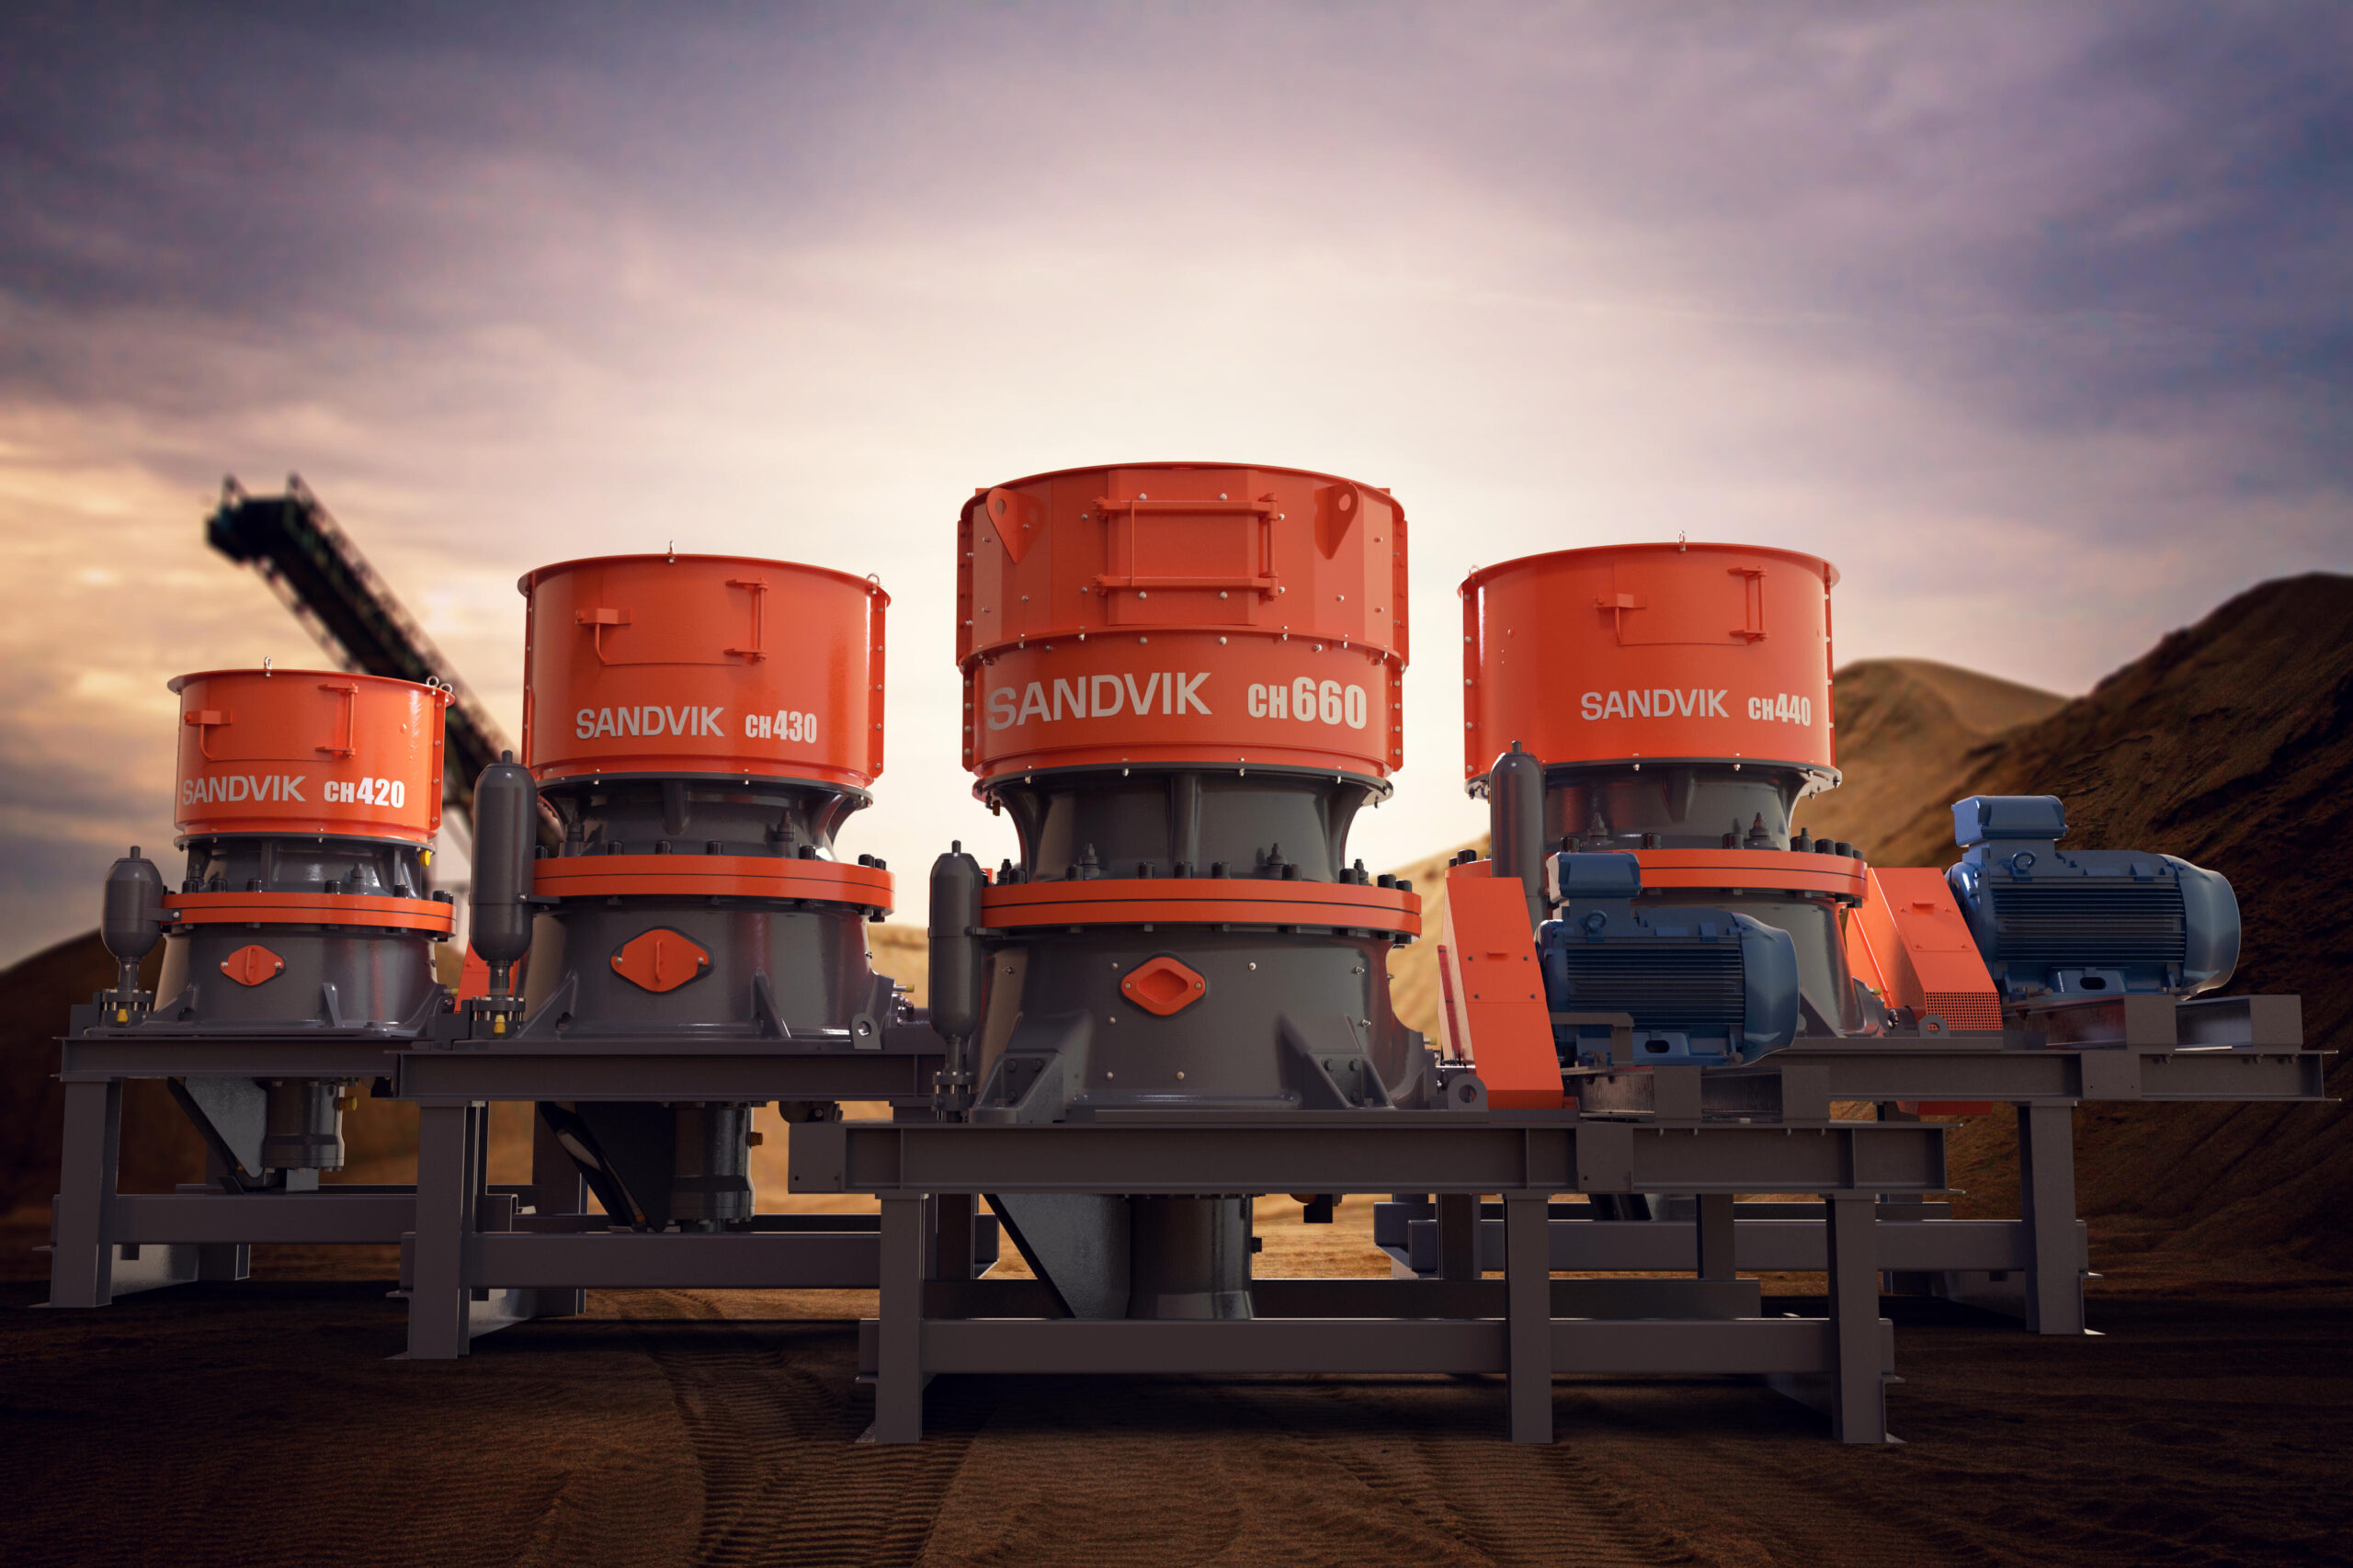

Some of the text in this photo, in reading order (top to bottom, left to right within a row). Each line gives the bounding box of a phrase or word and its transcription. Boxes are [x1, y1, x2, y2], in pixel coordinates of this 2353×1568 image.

[986, 672, 1367, 731] SANDVIK CH660
[1580, 688, 1811, 727] SANDVIK CH440
[575, 706, 817, 744] SANDVIK CH430
[182, 775, 404, 809] SANDVIK CH420
